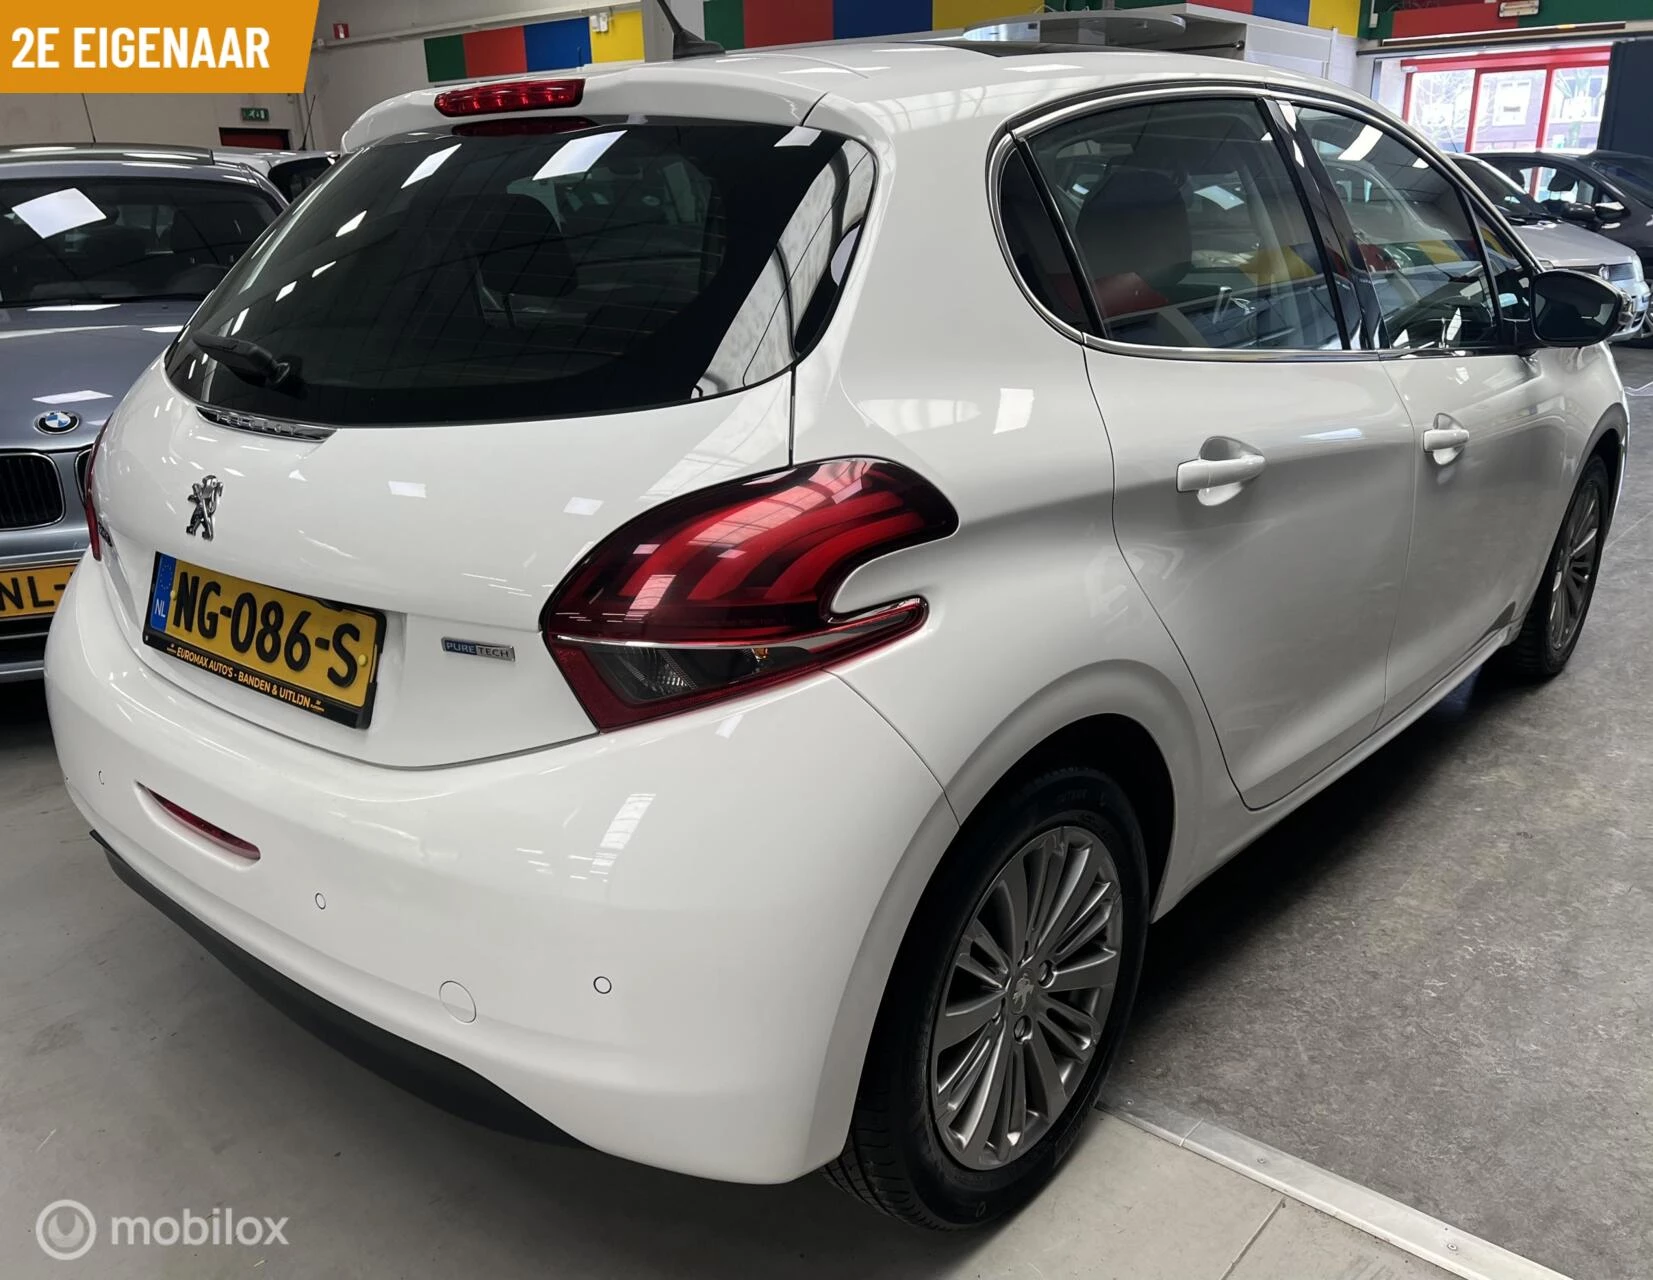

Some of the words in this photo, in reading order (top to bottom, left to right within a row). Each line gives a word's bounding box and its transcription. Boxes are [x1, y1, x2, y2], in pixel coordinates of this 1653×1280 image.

[154, 599, 166, 619] NL
[172, 571, 361, 688] NG-086-S
[176, 647, 209, 668] EUROMAX
[209, 660, 233, 678] AUTO'S
[238, 671, 271, 693] BANDEN
[271, 684, 278, 695] &
[279, 687, 312, 708] UITLIJN
